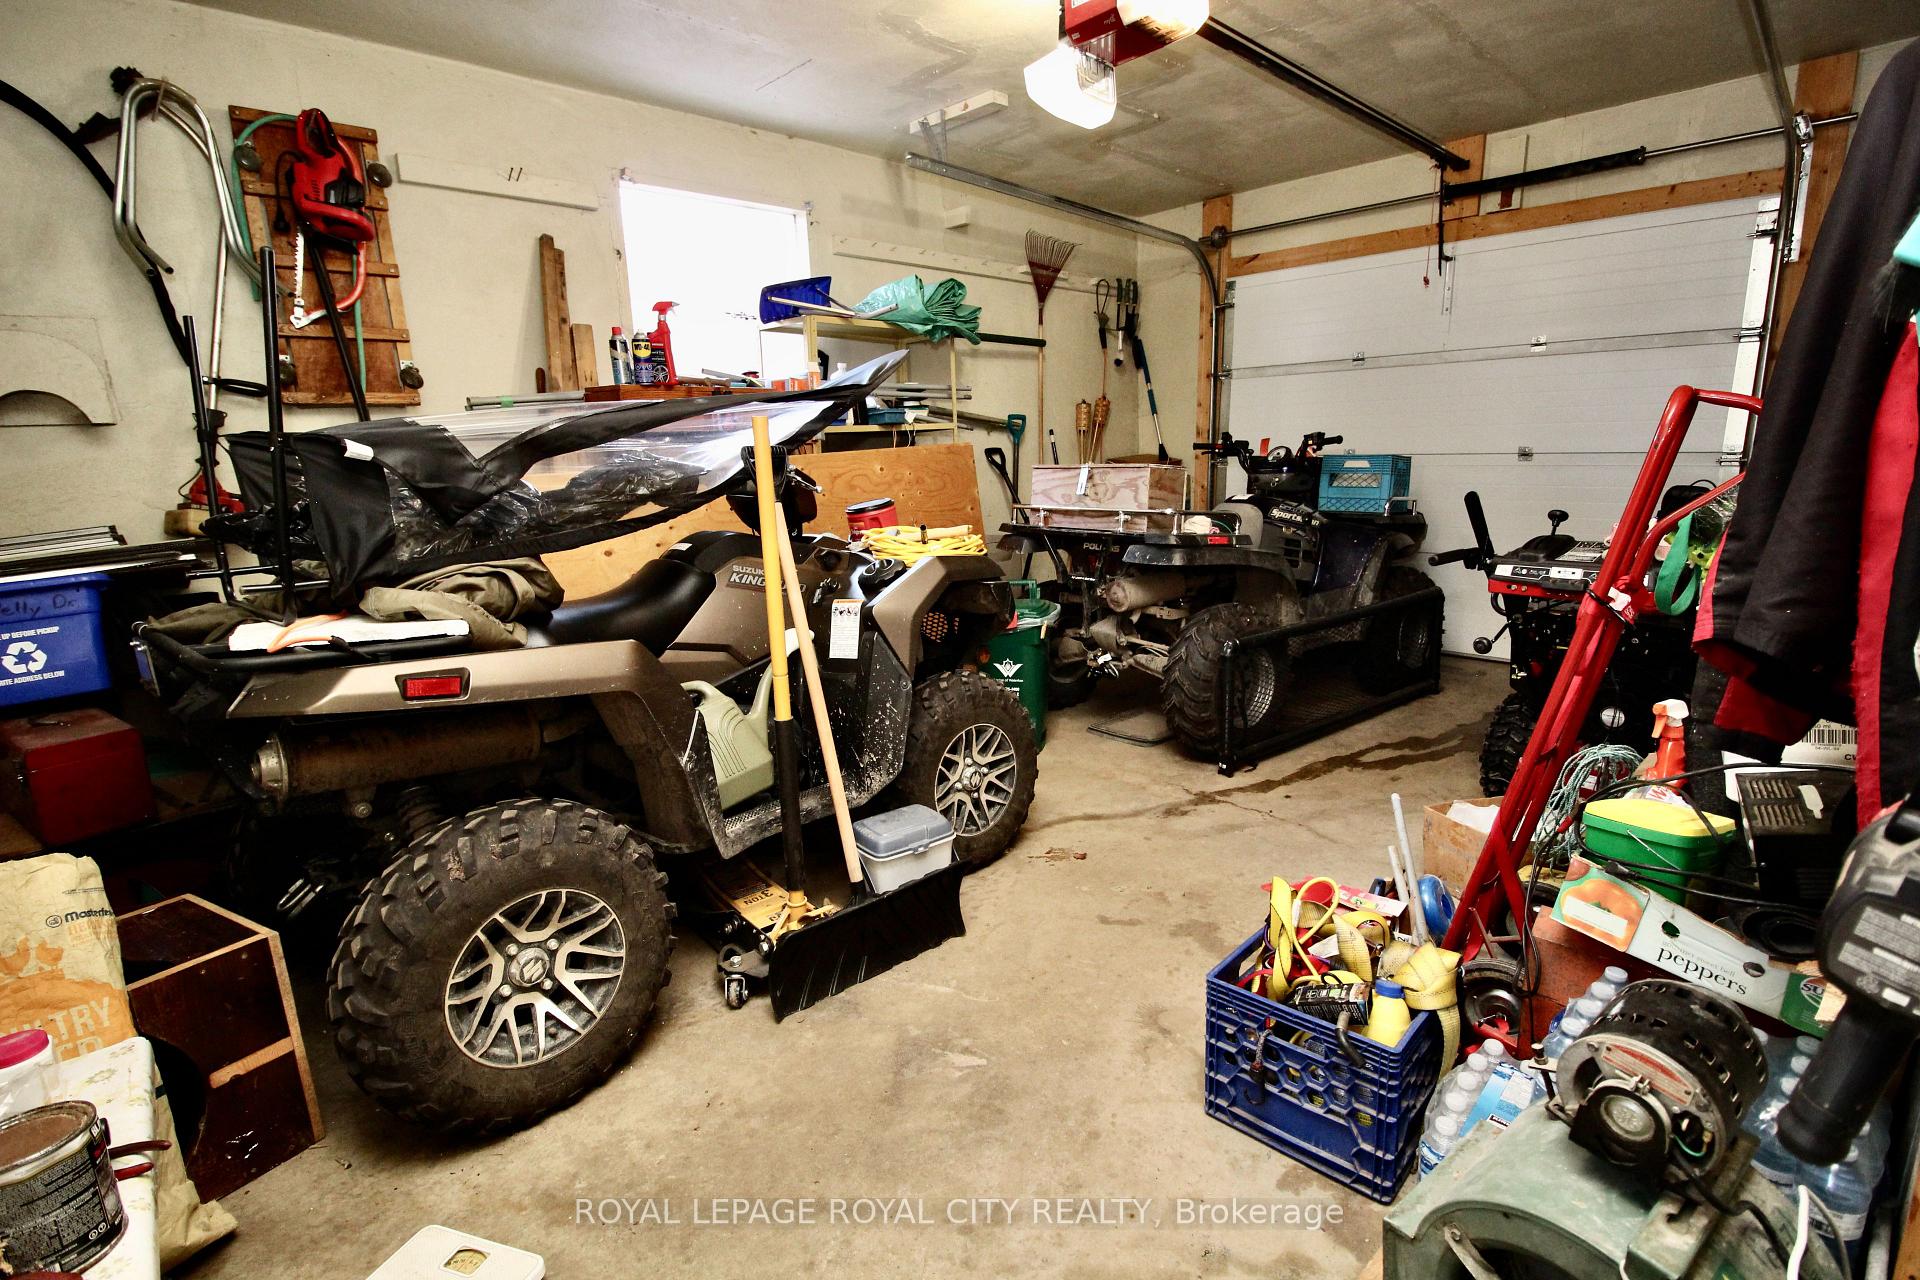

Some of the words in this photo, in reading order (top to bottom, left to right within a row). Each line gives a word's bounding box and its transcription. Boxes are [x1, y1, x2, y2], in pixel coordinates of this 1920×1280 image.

[633, 343, 650, 351] WD-40
[732, 564, 765, 576] SUZUK
[11, 629, 37, 639] BEFORE
[36, 626, 60, 636] PICKUP
[14, 673, 43, 684] ADDRESS
[43, 670, 65, 679] BELOW
[1656, 947, 1748, 995] peppers
